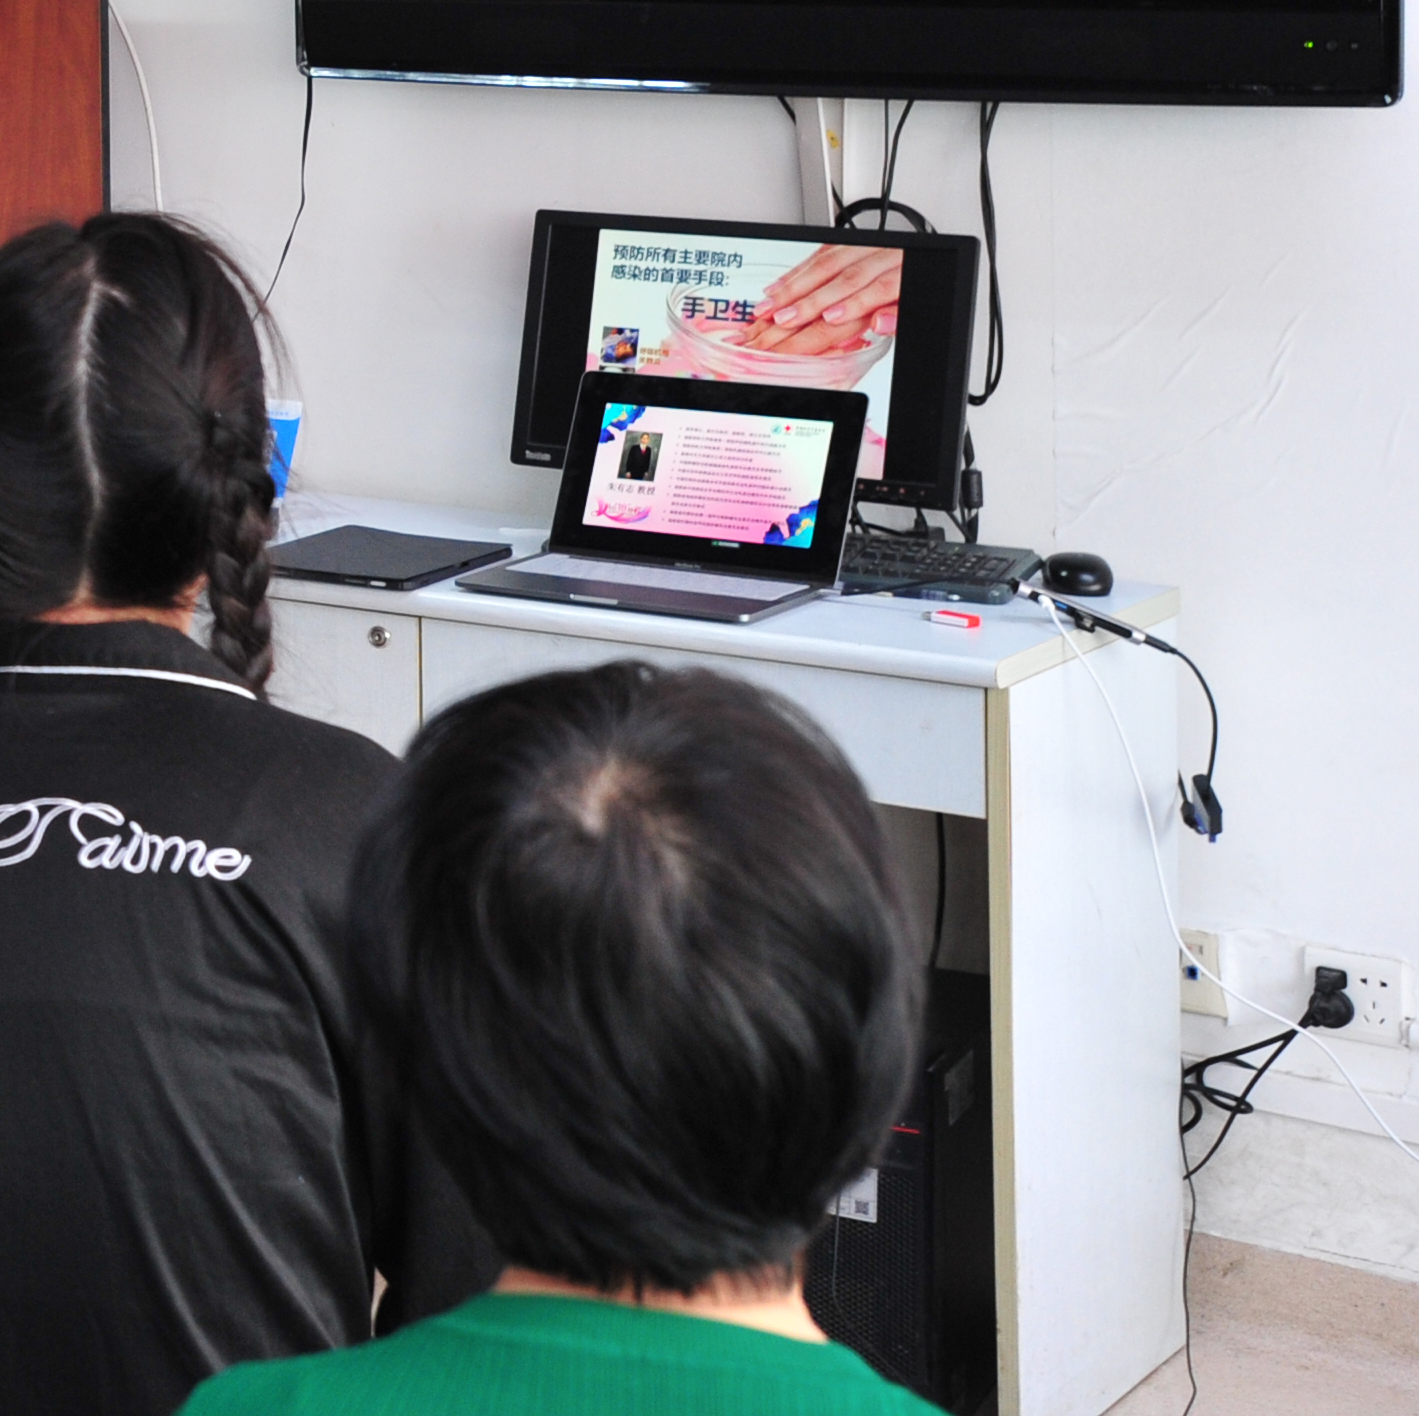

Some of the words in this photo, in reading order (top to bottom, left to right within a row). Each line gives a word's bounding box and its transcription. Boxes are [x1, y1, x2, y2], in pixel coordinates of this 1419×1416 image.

[612, 244, 743, 269] 预防所有主要院内
[681, 295, 756, 323] 手卫生
